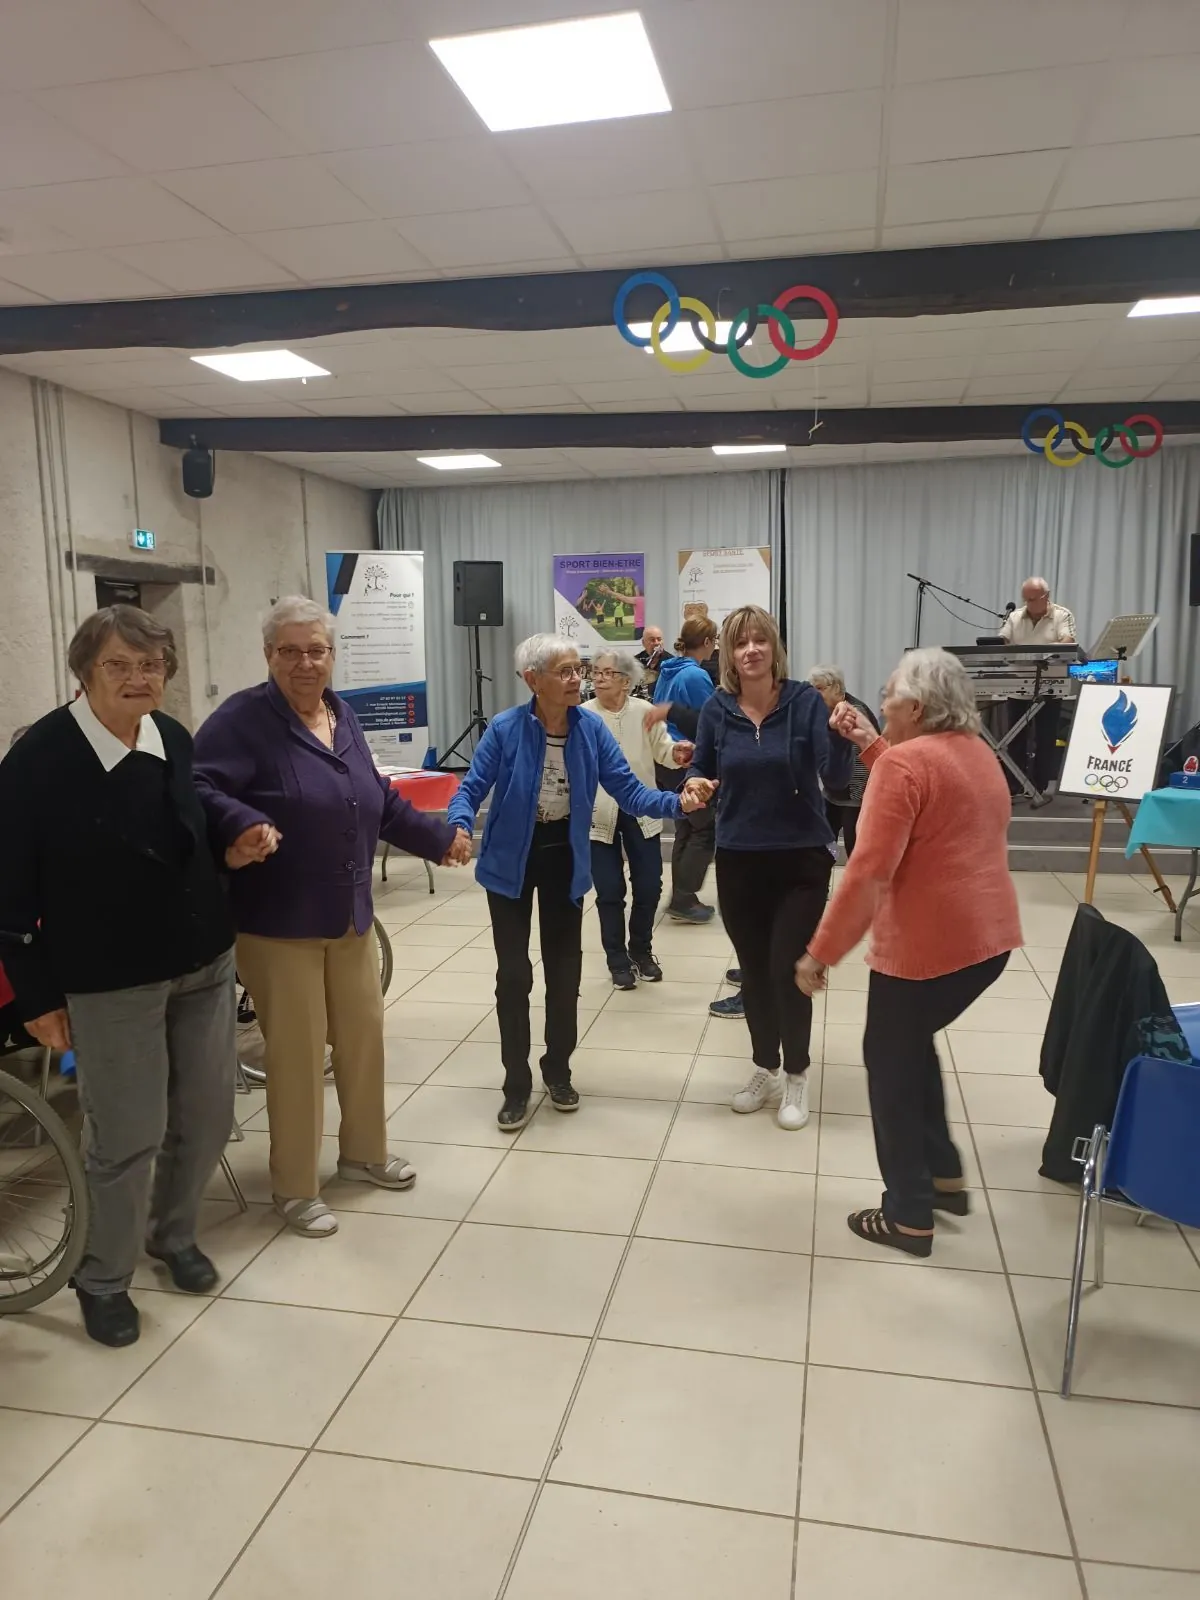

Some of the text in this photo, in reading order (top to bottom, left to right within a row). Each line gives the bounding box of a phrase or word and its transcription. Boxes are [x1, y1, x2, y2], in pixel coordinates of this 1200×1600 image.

[560, 559, 641, 569] SPORT BIEN-ETRE
[1087, 755, 1133, 772] FRANCE
[1182, 776, 1189, 784] 2
